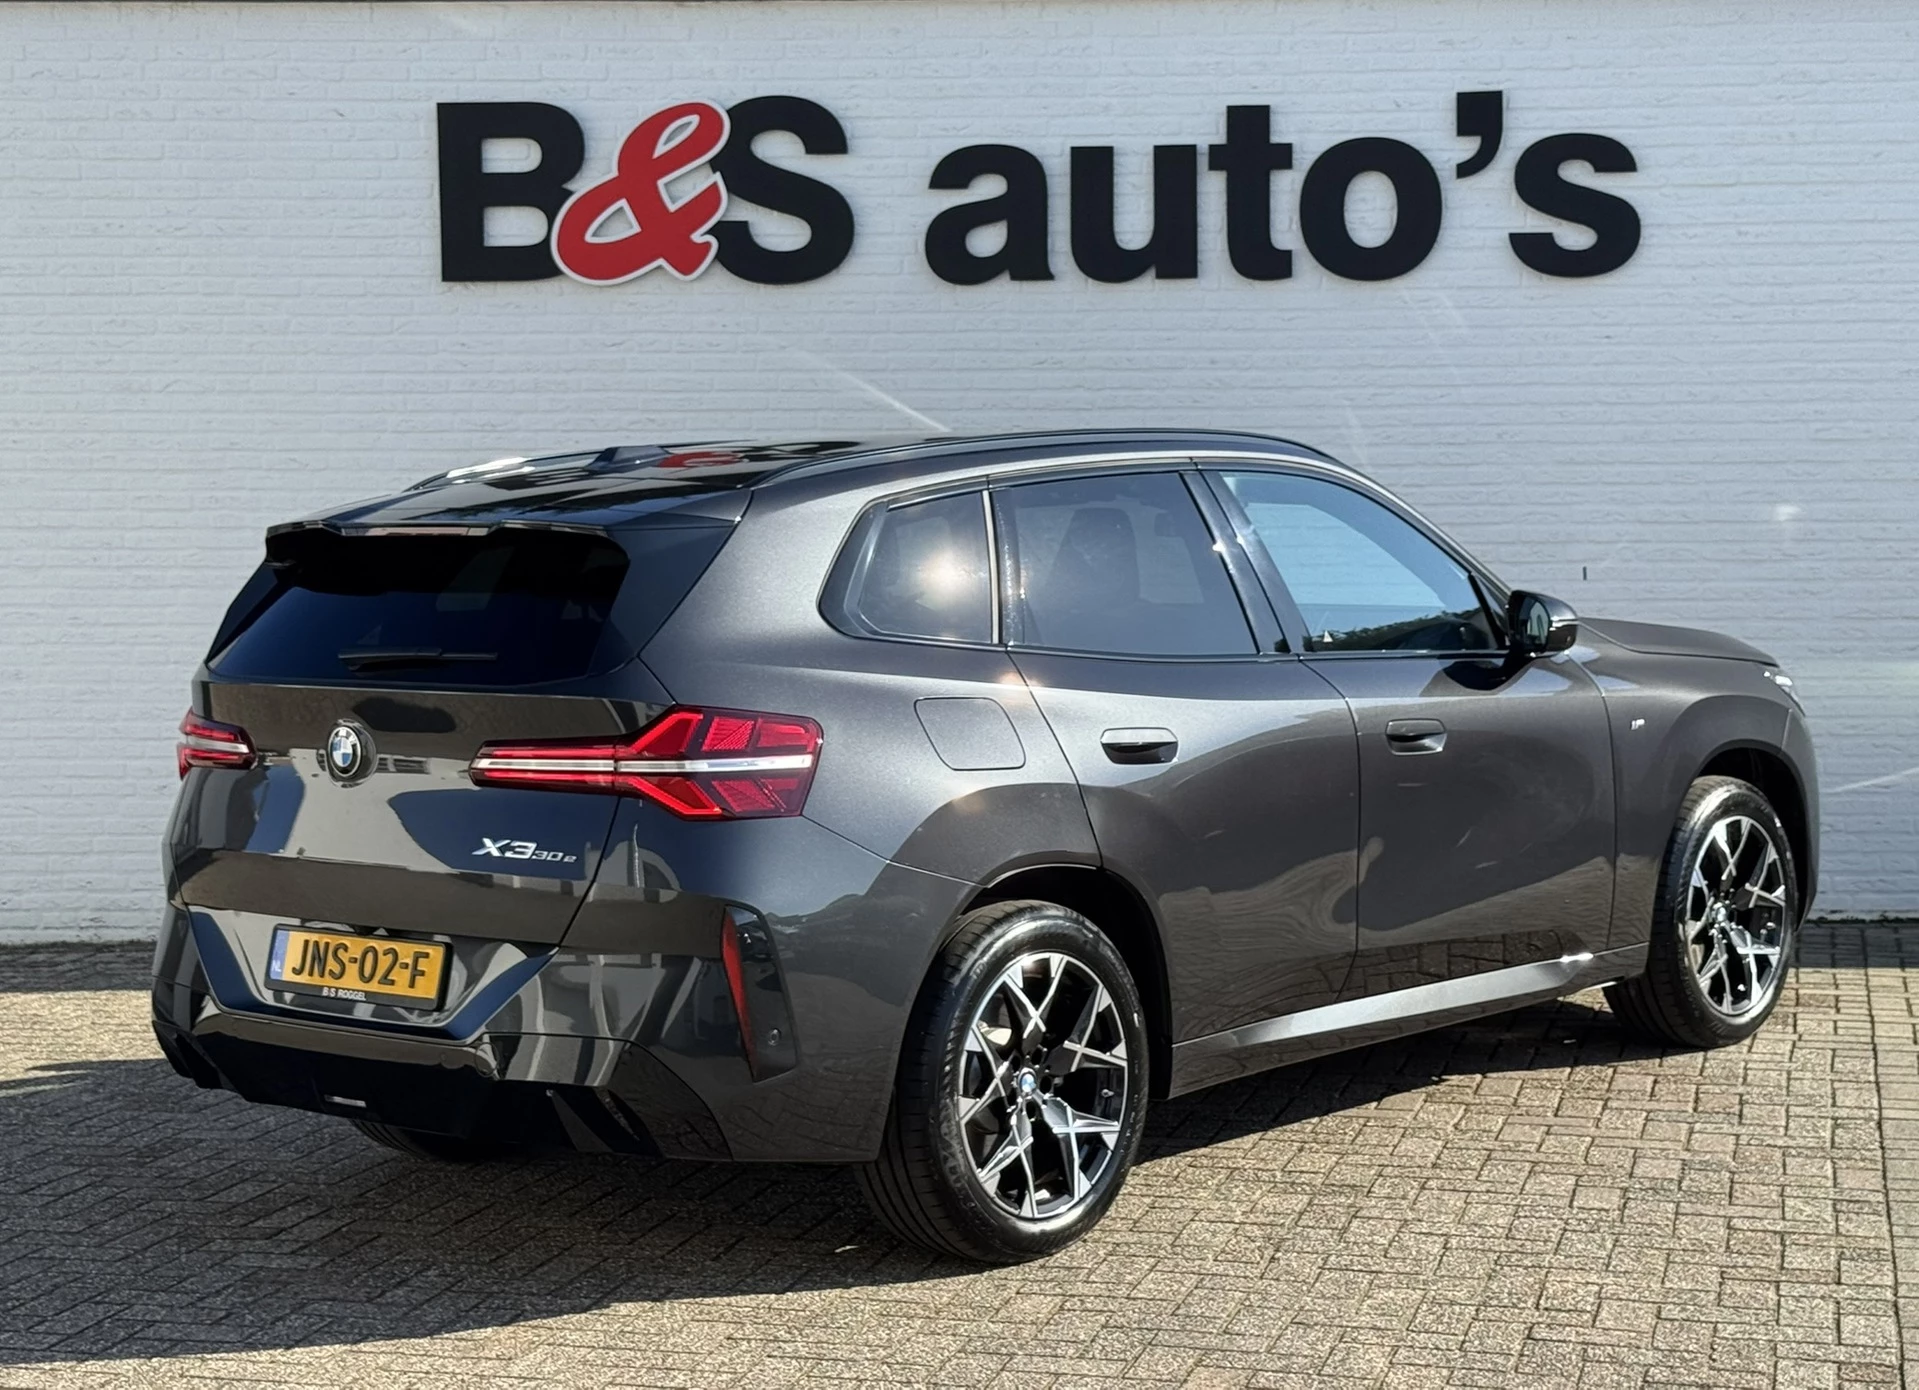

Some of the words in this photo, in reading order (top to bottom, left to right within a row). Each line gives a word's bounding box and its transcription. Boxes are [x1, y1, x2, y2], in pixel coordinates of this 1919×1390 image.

[437, 95, 855, 286] B&S
[925, 90, 1641, 285] auto's
[291, 938, 430, 989] JNS-02-F
